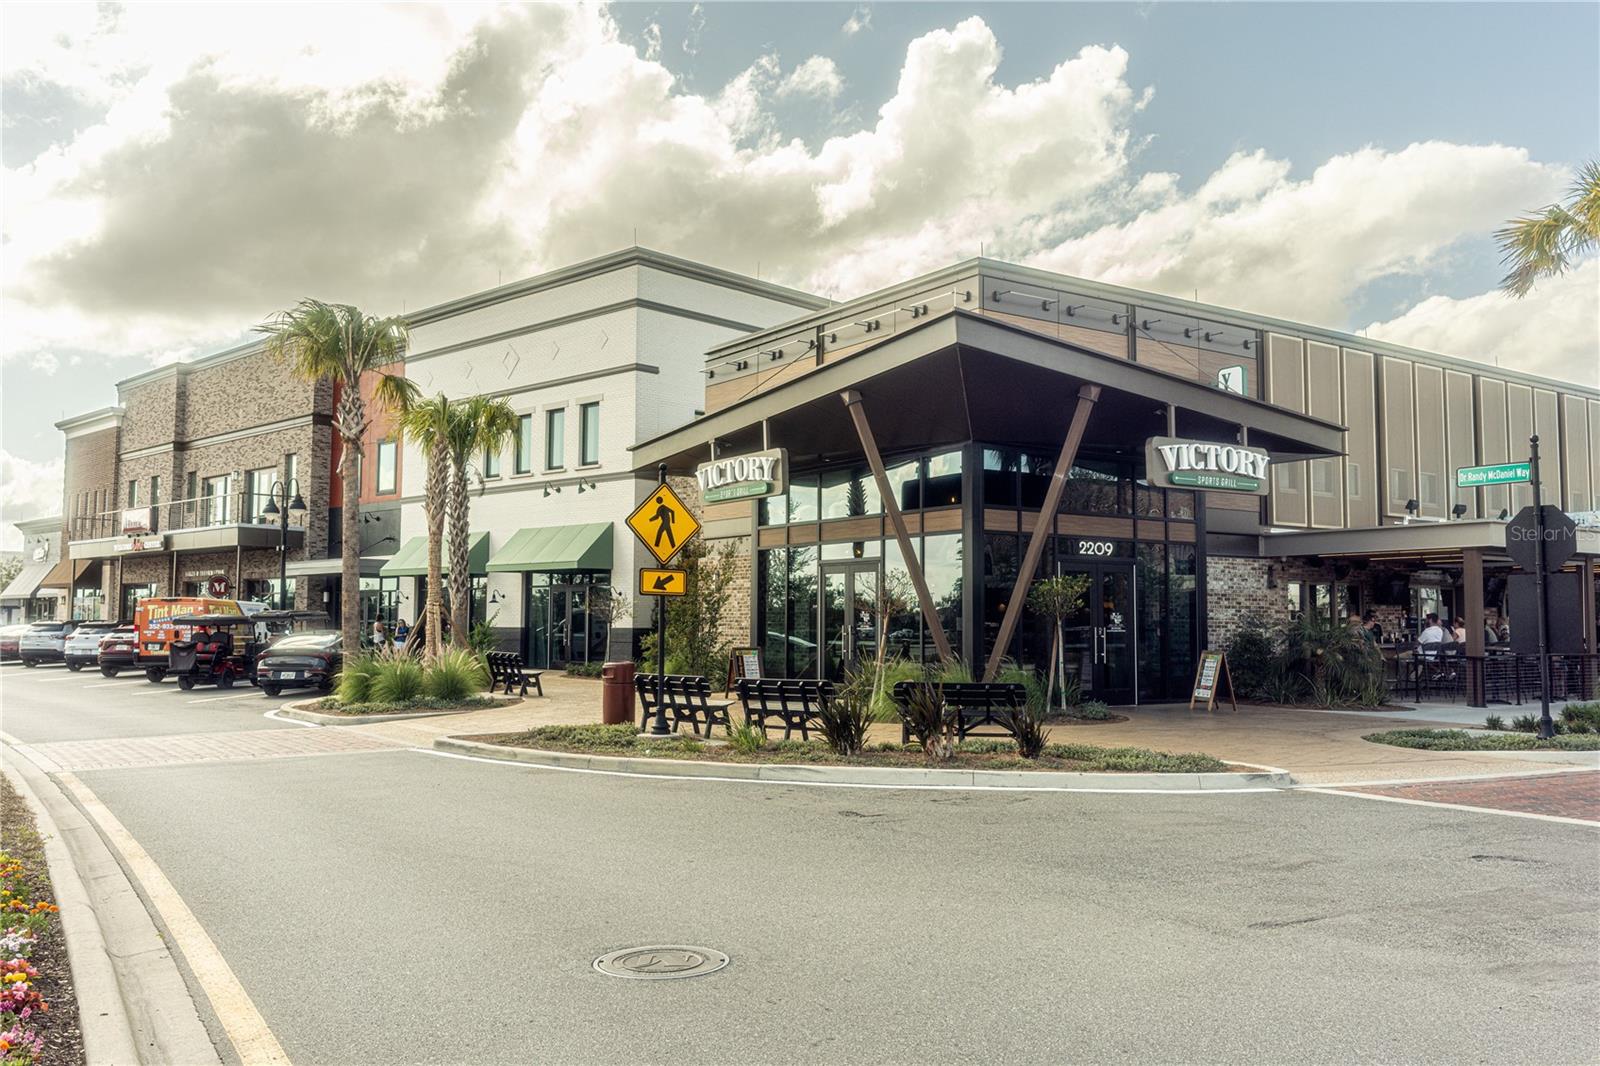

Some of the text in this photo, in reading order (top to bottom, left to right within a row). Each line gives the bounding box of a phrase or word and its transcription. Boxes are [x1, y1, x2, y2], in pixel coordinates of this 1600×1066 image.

[1158, 443, 1271, 480] VICTORY
[695, 457, 776, 491] VICTORY
[1198, 475, 1237, 488] SPORTS GRILL
[1468, 472, 1487, 482] Randy
[1488, 468, 1515, 480] McDaniel
[1516, 467, 1530, 479] Way
[1079, 541, 1113, 556] 2209
[212, 582, 226, 593] M
[147, 604, 193, 619] Tint Man
